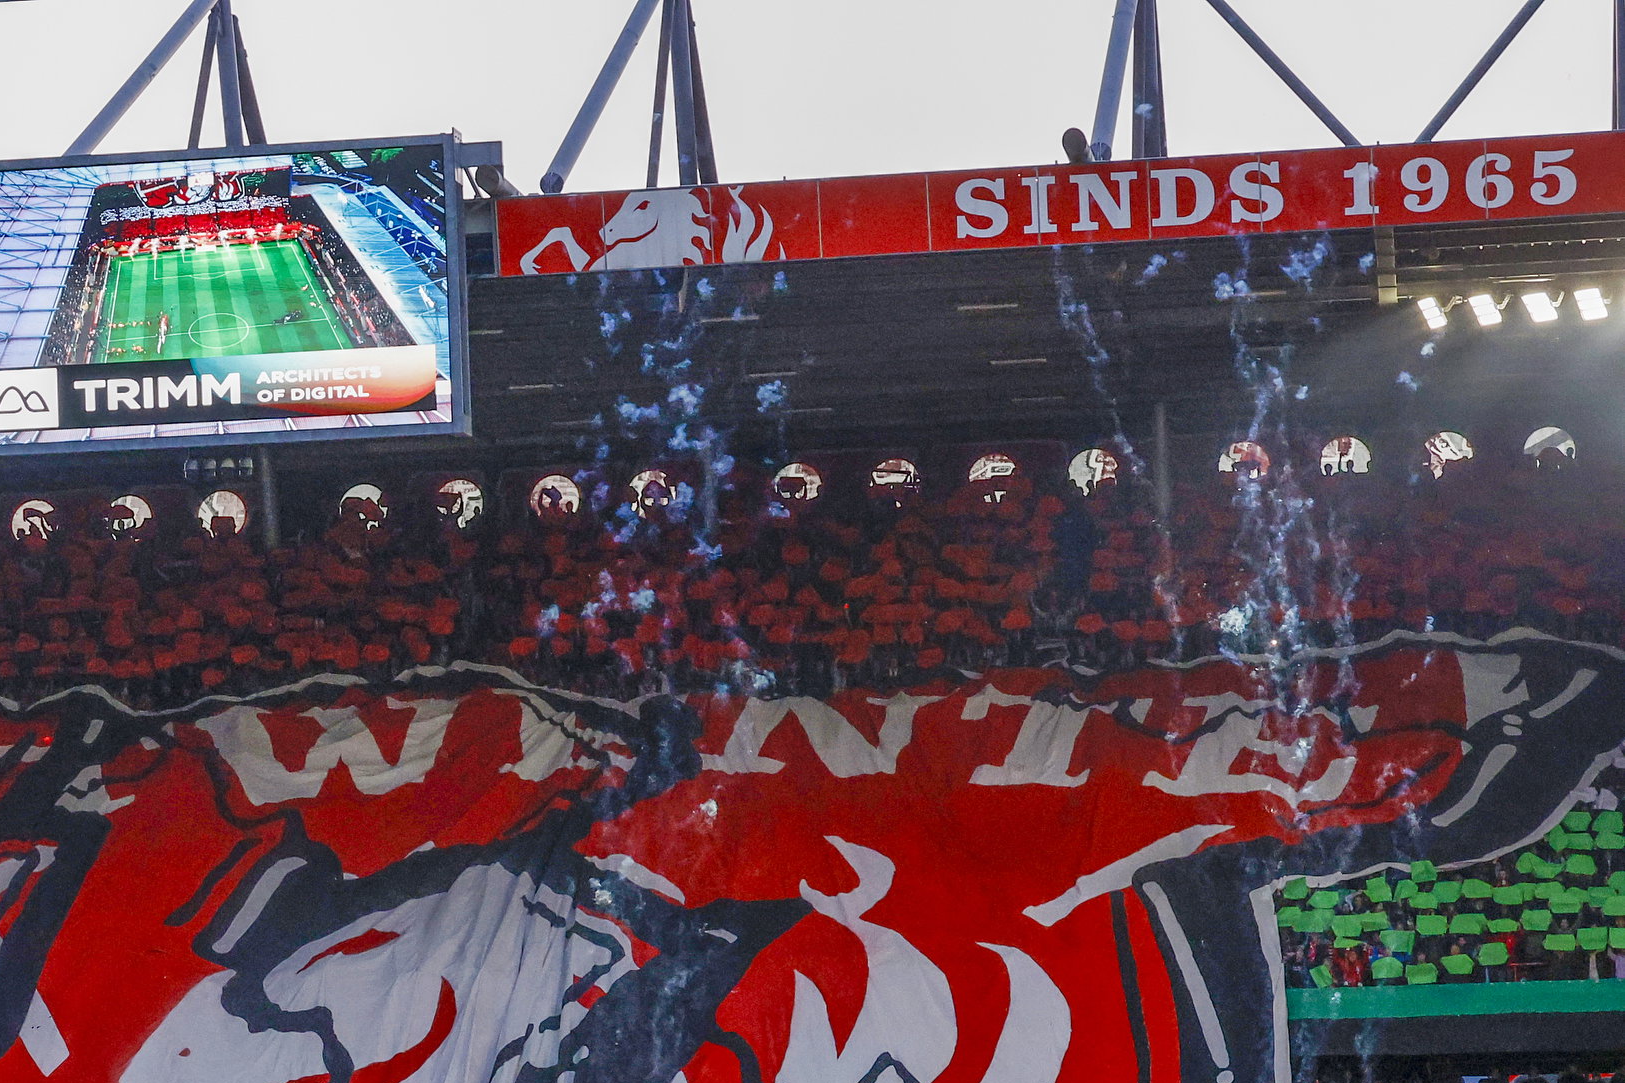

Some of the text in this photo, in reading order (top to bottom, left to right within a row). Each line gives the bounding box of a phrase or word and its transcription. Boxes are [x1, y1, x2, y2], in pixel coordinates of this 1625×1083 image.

[955, 147, 1579, 240] SINDS 1965
[255, 365, 383, 385] ARCHITECTS
[74, 373, 242, 413] TRIMM
[256, 384, 370, 403] OF DIGITAL
